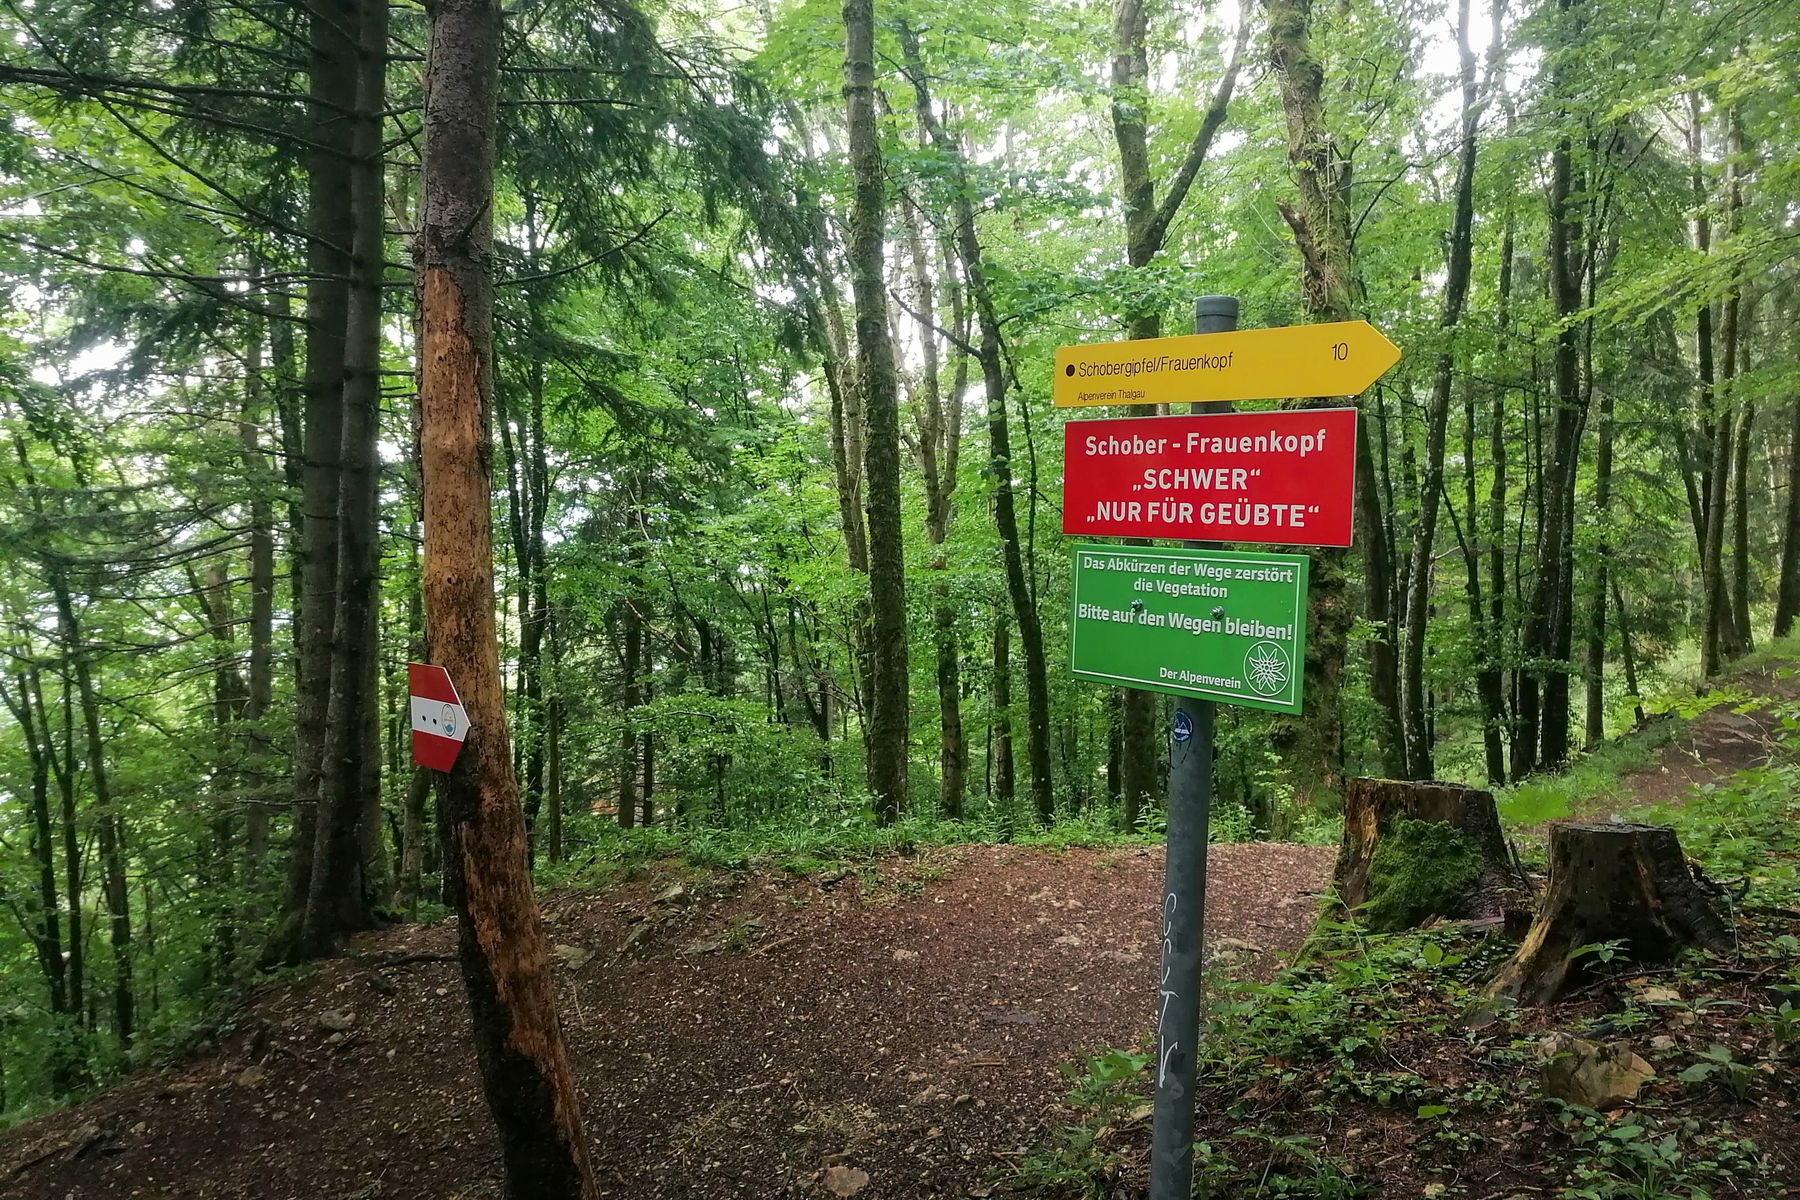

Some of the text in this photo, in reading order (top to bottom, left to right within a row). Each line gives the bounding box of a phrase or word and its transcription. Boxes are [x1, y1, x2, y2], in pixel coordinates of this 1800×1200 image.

[1078, 343, 1349, 377] Schobergipfel/Frauenkopf 10
[1078, 389, 1146, 402] Alpenverein Thalgau
[1085, 434, 1167, 456] Schober
[1187, 429, 1326, 457] Frauenkopf
[1147, 497, 1194, 524] FÜR
[1083, 556, 1293, 583] Das Abkürzen der Wege zerstört
[1133, 578, 1228, 598] die Vegetation
[1079, 603, 1293, 641] Bitte auf den Wegen bleiben!
[1159, 667, 1241, 690] Der Alpenverein
